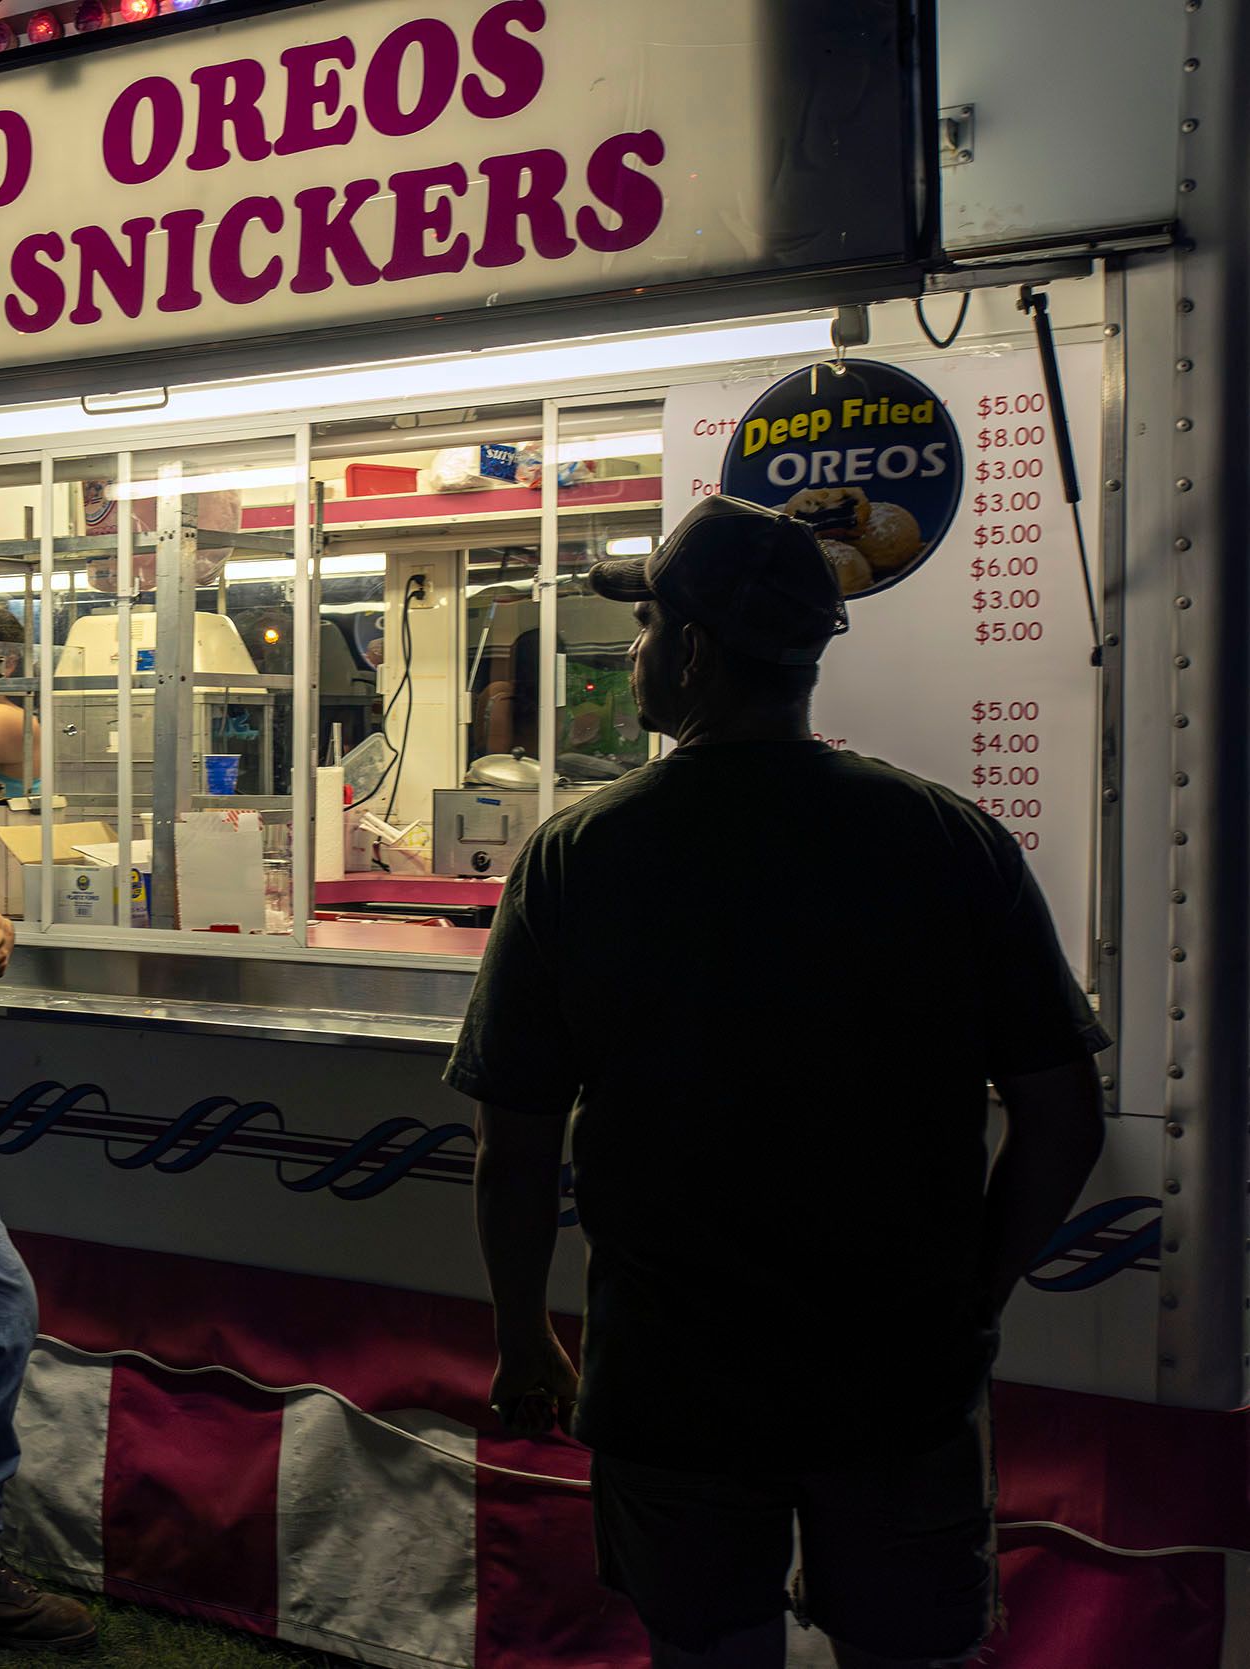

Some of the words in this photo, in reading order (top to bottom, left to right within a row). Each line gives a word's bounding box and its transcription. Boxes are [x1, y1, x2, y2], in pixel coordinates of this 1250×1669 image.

[103, 0, 546, 184] OREOS
[5, 131, 665, 333] SNICKERS
[977, 393, 1045, 420] $5.00
[694, 418, 736, 436] Cott
[743, 409, 832, 457] Deep
[841, 398, 935, 428] Fried
[976, 425, 1045, 452] $8.00
[767, 443, 947, 487] OREOS
[974, 458, 1043, 484] $3.00
[973, 491, 1041, 516] $3.00
[973, 524, 1041, 549] $5.00
[969, 556, 1038, 581] $6.00
[972, 589, 1040, 613] $3.00
[974, 621, 1043, 645] $5.00
[971, 700, 1039, 724] $5.00
[971, 732, 1039, 756] $4.00
[971, 765, 1039, 788] $5.00
